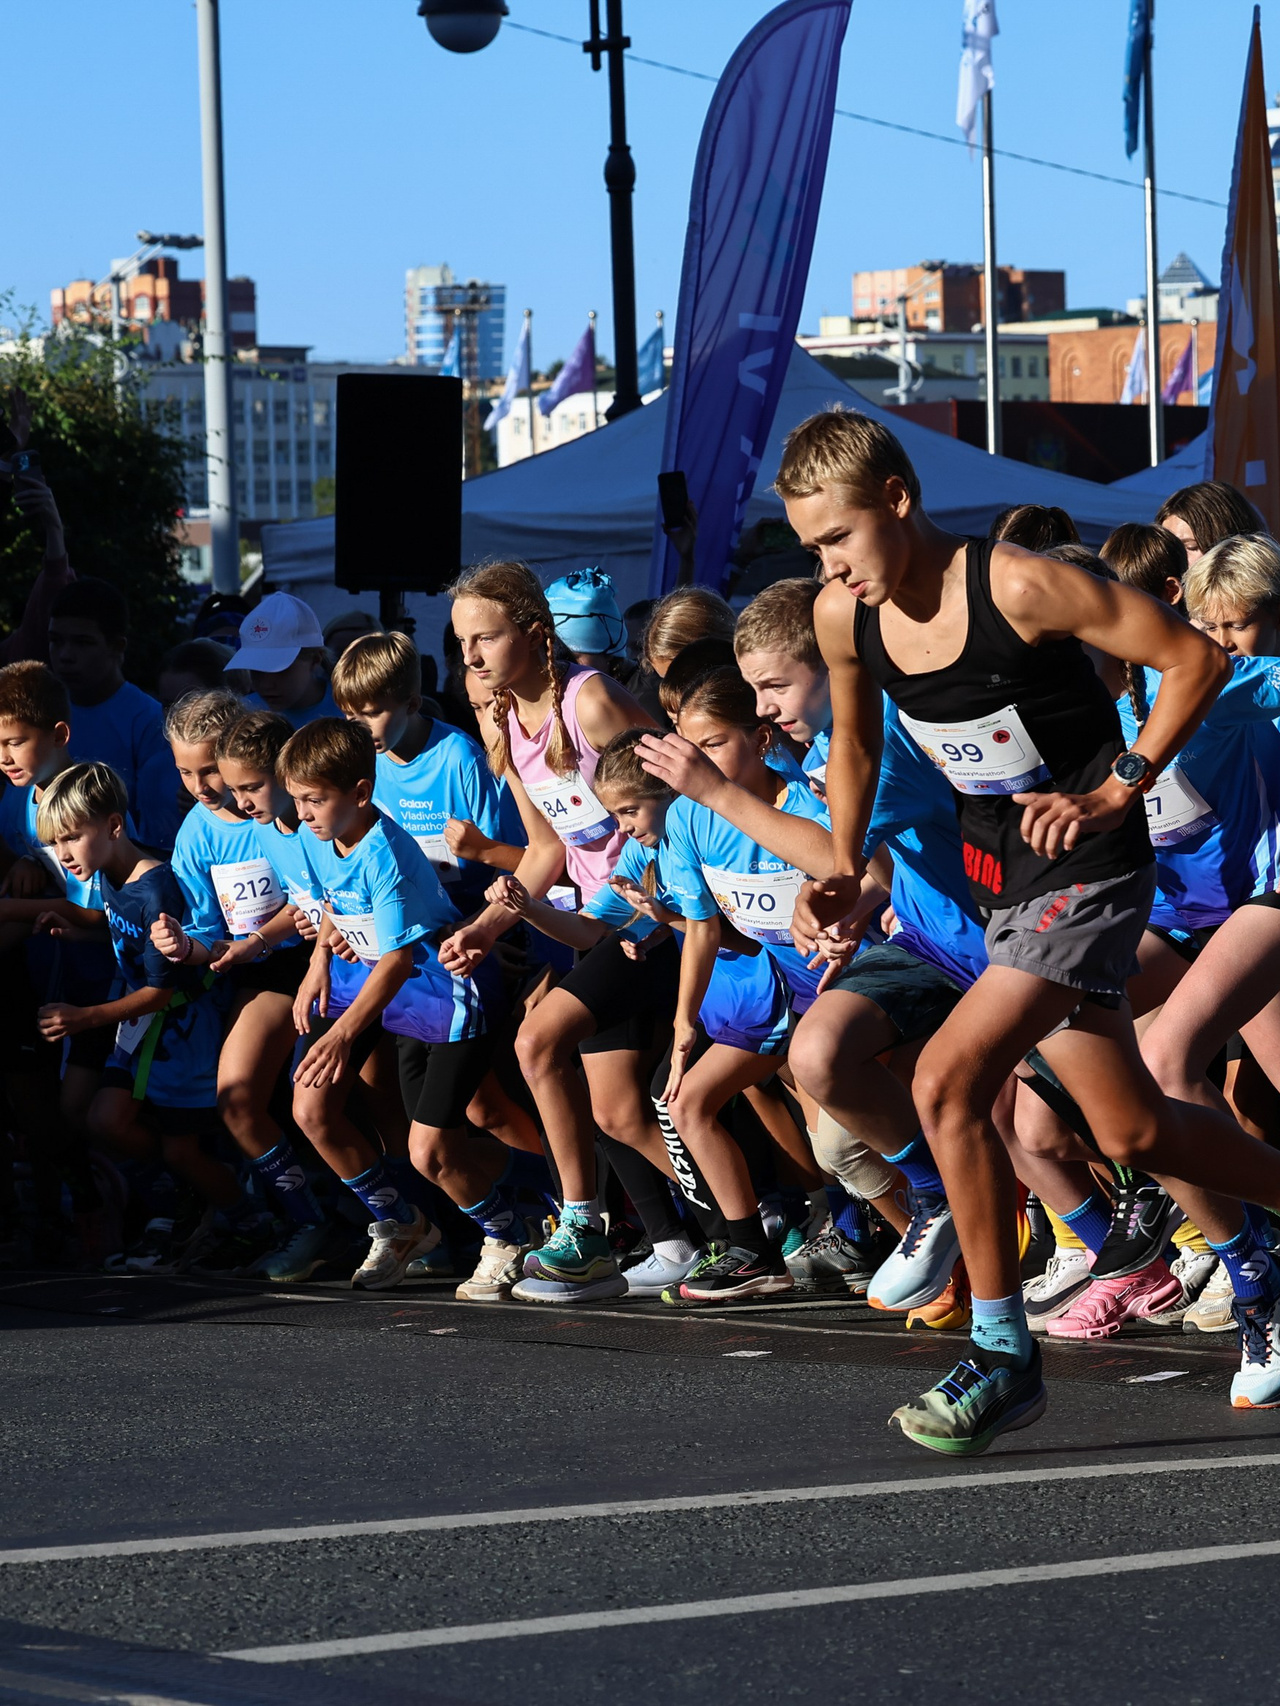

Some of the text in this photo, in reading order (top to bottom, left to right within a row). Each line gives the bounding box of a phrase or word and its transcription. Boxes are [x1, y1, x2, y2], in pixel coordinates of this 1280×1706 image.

[942, 743, 984, 763] 99
[1001, 775, 1034, 791] 1km
[399, 798, 433, 811] Galaxy
[543, 798, 568, 818] 84
[1146, 796, 1162, 818] 7
[400, 811, 458, 821] Vladivostok
[233, 876, 273, 902] 212
[235, 901, 278, 916] #GalaxyMarathon
[731, 891, 776, 912] 170
